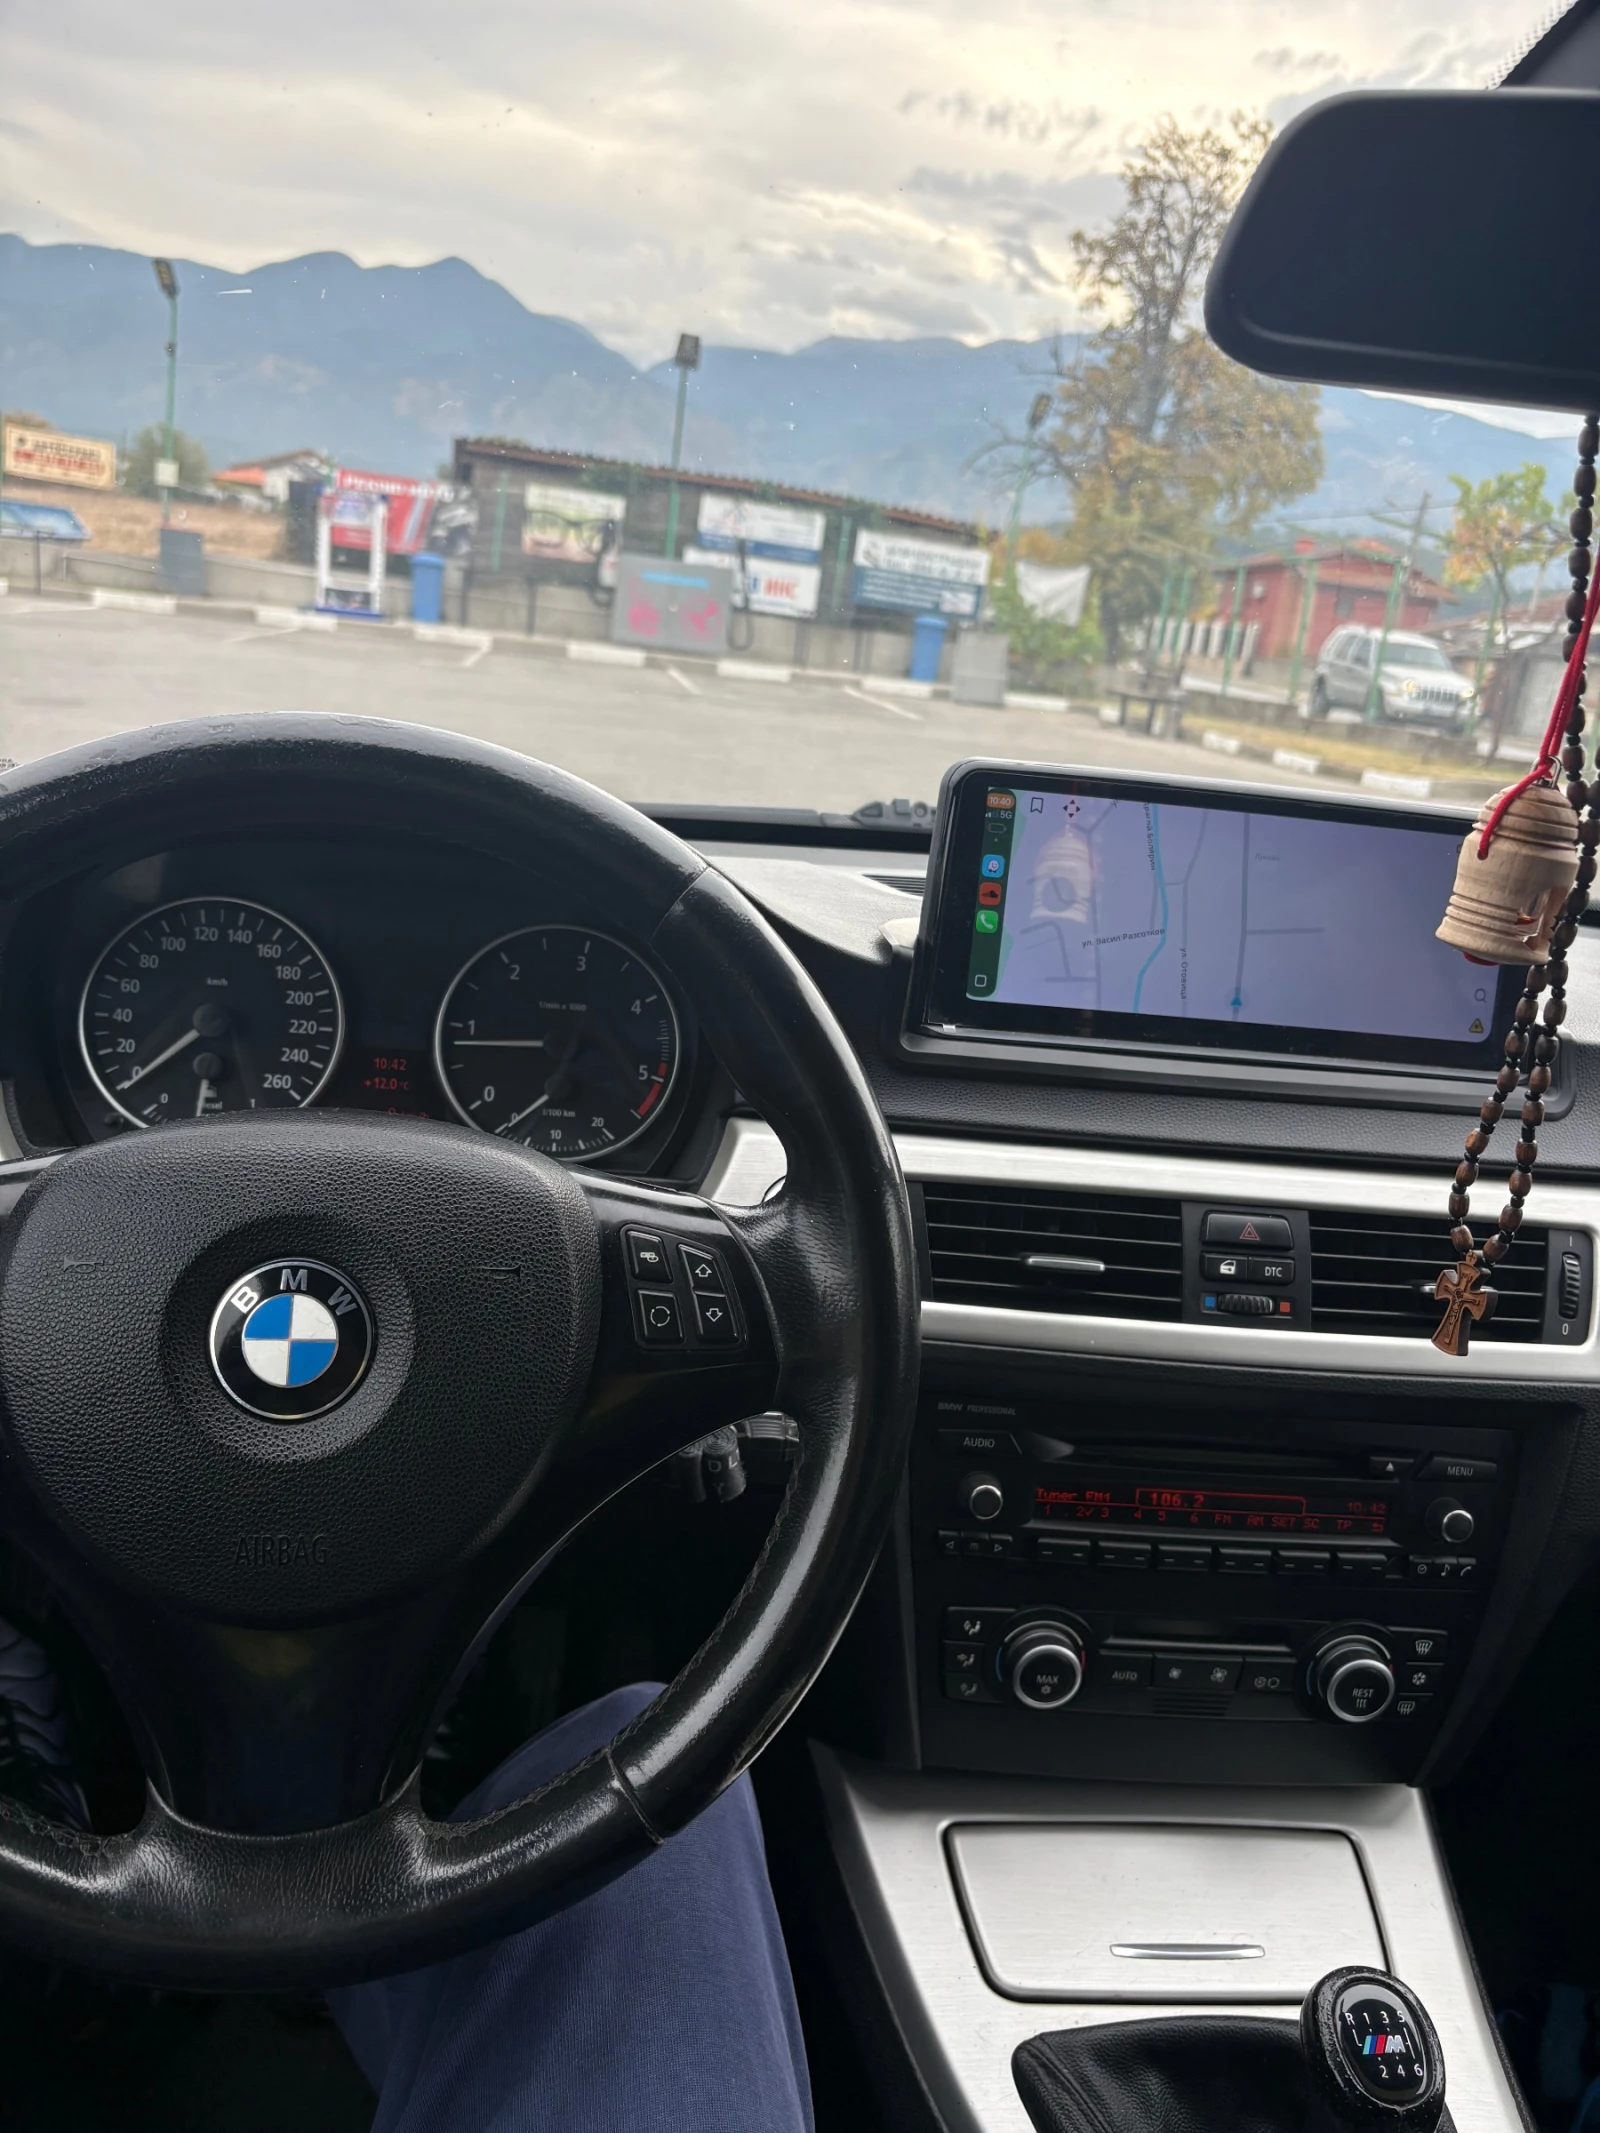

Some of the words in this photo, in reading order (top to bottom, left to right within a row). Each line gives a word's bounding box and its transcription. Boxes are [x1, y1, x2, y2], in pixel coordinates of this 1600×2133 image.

[989, 796, 1011, 806] 10:40
[1000, 811, 1012, 819] 5G
[1147, 833, 1156, 870] Болярин
[194, 926, 219, 941] 120
[227, 929, 253, 944] 140
[161, 936, 186, 952] 100
[1081, 940, 1092, 949] ул.
[257, 944, 282, 959] 160
[1179, 947, 1187, 960] ул.
[139, 954, 159, 969] 80
[576, 956, 587, 972] 3
[275, 965, 301, 980] 180
[510, 965, 521, 980] 2
[121, 979, 140, 993] 60
[207, 977, 228, 987] km/h
[1180, 961, 1188, 1000] Отовица
[285, 991, 313, 1006] 200
[631, 1000, 642, 1014] 4
[112, 1008, 132, 1023] 40
[289, 1020, 317, 1034] 220
[467, 1020, 475, 1035] 1
[116, 1038, 135, 1054] 20
[281, 1048, 309, 1064] 240
[374, 1057, 407, 1071] 10:42
[132, 1066, 142, 1080] 0
[638, 1065, 648, 1080] 5
[263, 1074, 292, 1089] 260
[160, 1093, 168, 1104] 0
[484, 1085, 495, 1102] 0
[511, 1113, 518, 1122] 0
[563, 1110, 576, 1118] km
[591, 1117, 604, 1127] 20
[550, 1129, 562, 1140] 10
[1264, 1265, 1283, 1278] DTC
[230, 1268, 357, 1316] BMW
[1562, 1323, 1569, 1336] 0
[937, 1402, 963, 1411] BMW
[967, 1404, 1016, 1416] PROFESSIONAL
[963, 1437, 996, 1448] AUDIO
[1447, 1466, 1474, 1476] MENU
[1036, 1488, 1078, 1500] Tuner
[1085, 1491, 1110, 1502] FM1
[1151, 1492, 1204, 1508] 106.2
[1044, 1504, 1051, 1516] 1
[1101, 1506, 1110, 1518] 3
[1133, 1509, 1142, 1520] 4
[1158, 1510, 1166, 1521] 5
[1190, 1512, 1199, 1523] 6
[1214, 1513, 1232, 1524] FM
[1246, 1516, 1264, 1526] AM
[1271, 1516, 1296, 1528] SET
[1302, 1518, 1320, 1529] SC
[1336, 1519, 1352, 1530] TP
[1036, 1674, 1059, 1685] MAX
[1111, 1670, 1138, 1681] AUTO
[1352, 1688, 1374, 1699] REST
[1345, 2012, 1355, 2026] R
[1363, 2012, 1370, 2025] 1
[1380, 2011, 1389, 2024] 3
[1396, 2010, 1406, 2023] 5
[1380, 2065, 1389, 2079] 2
[1397, 2064, 1406, 2077] 4
[1414, 2063, 1423, 2076] 6
